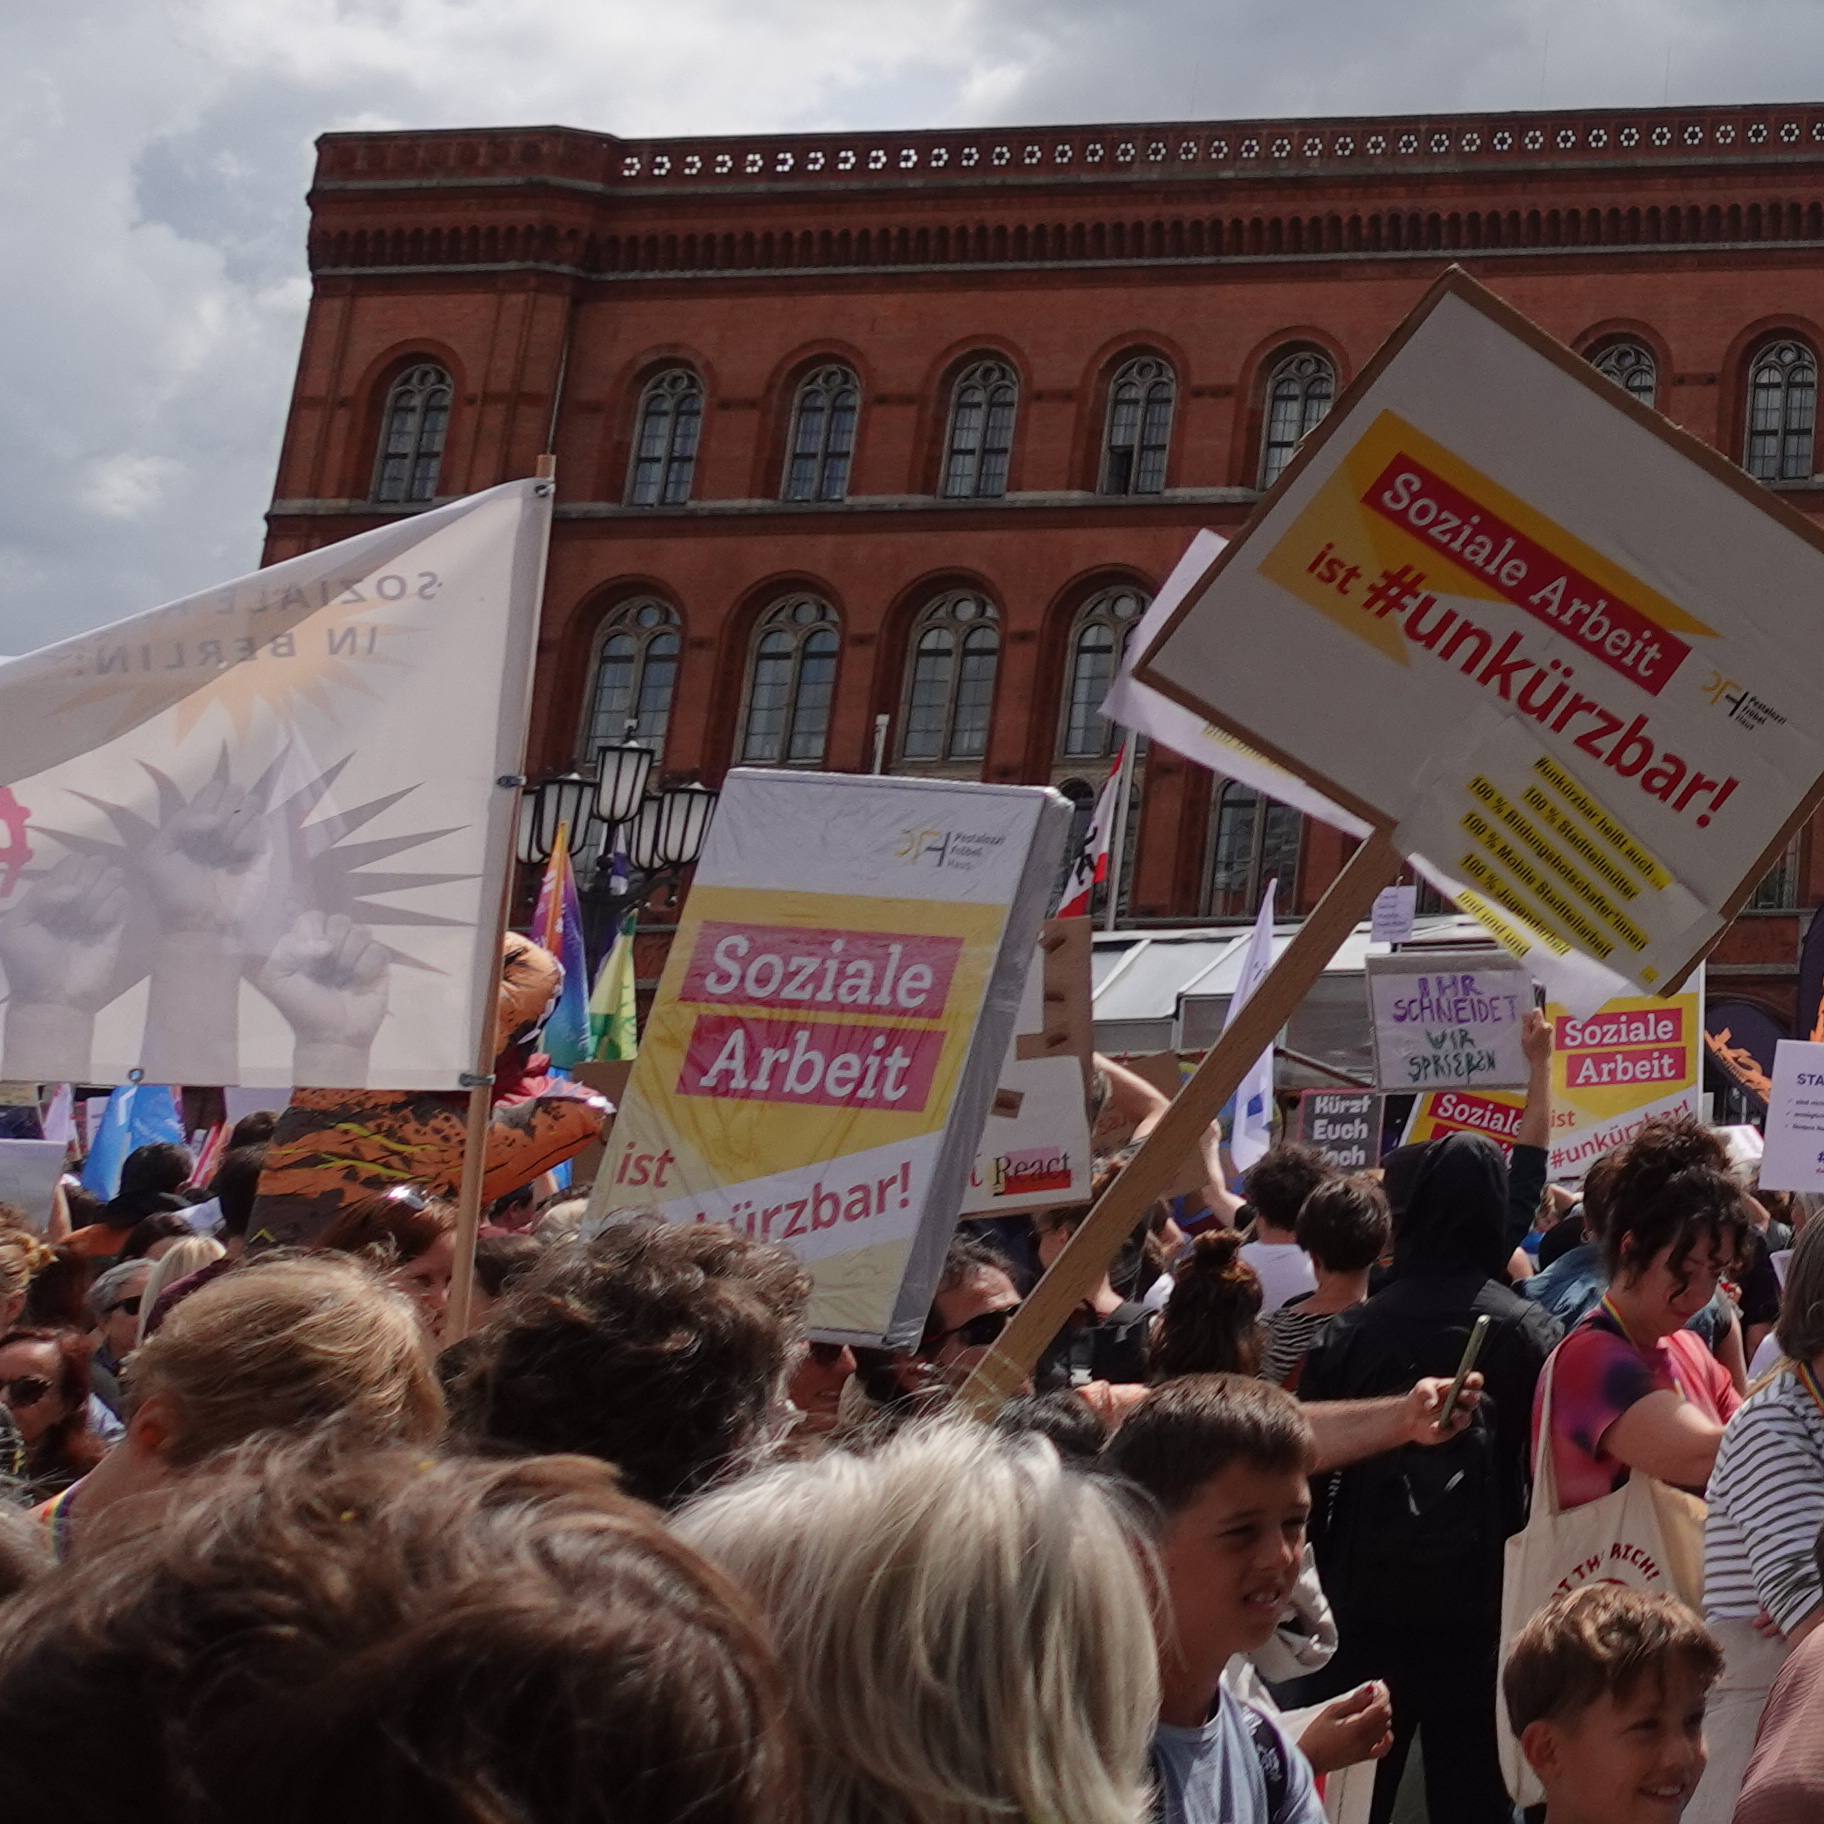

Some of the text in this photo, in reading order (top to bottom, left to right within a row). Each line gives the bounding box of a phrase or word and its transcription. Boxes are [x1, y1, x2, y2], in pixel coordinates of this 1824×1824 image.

[1382, 472, 1666, 677] Soziale Arbeit
[1306, 542, 1739, 829] ist #unkürzbar!
[1469, 776, 1494, 801] 100
[1522, 786, 1547, 811] 100
[1462, 812, 1487, 837] 100
[1461, 854, 1487, 877] 100
[705, 933, 934, 1009] Soziale
[1391, 994, 1519, 1023] SCHNEIDET
[1425, 1028, 1477, 1051] WIR
[1564, 1012, 1674, 1047] Soziale
[699, 1028, 913, 1103] Arbeit
[1575, 1051, 1677, 1085] Arbeit
[1313, 1093, 1373, 1115] Kürzt
[1437, 1094, 1524, 1137] Soziale
[1550, 1109, 1576, 1128] ist
[1311, 1118, 1369, 1141] Euch
[616, 1141, 675, 1188] ist
[1609, 1541, 1661, 1582] RICH!
